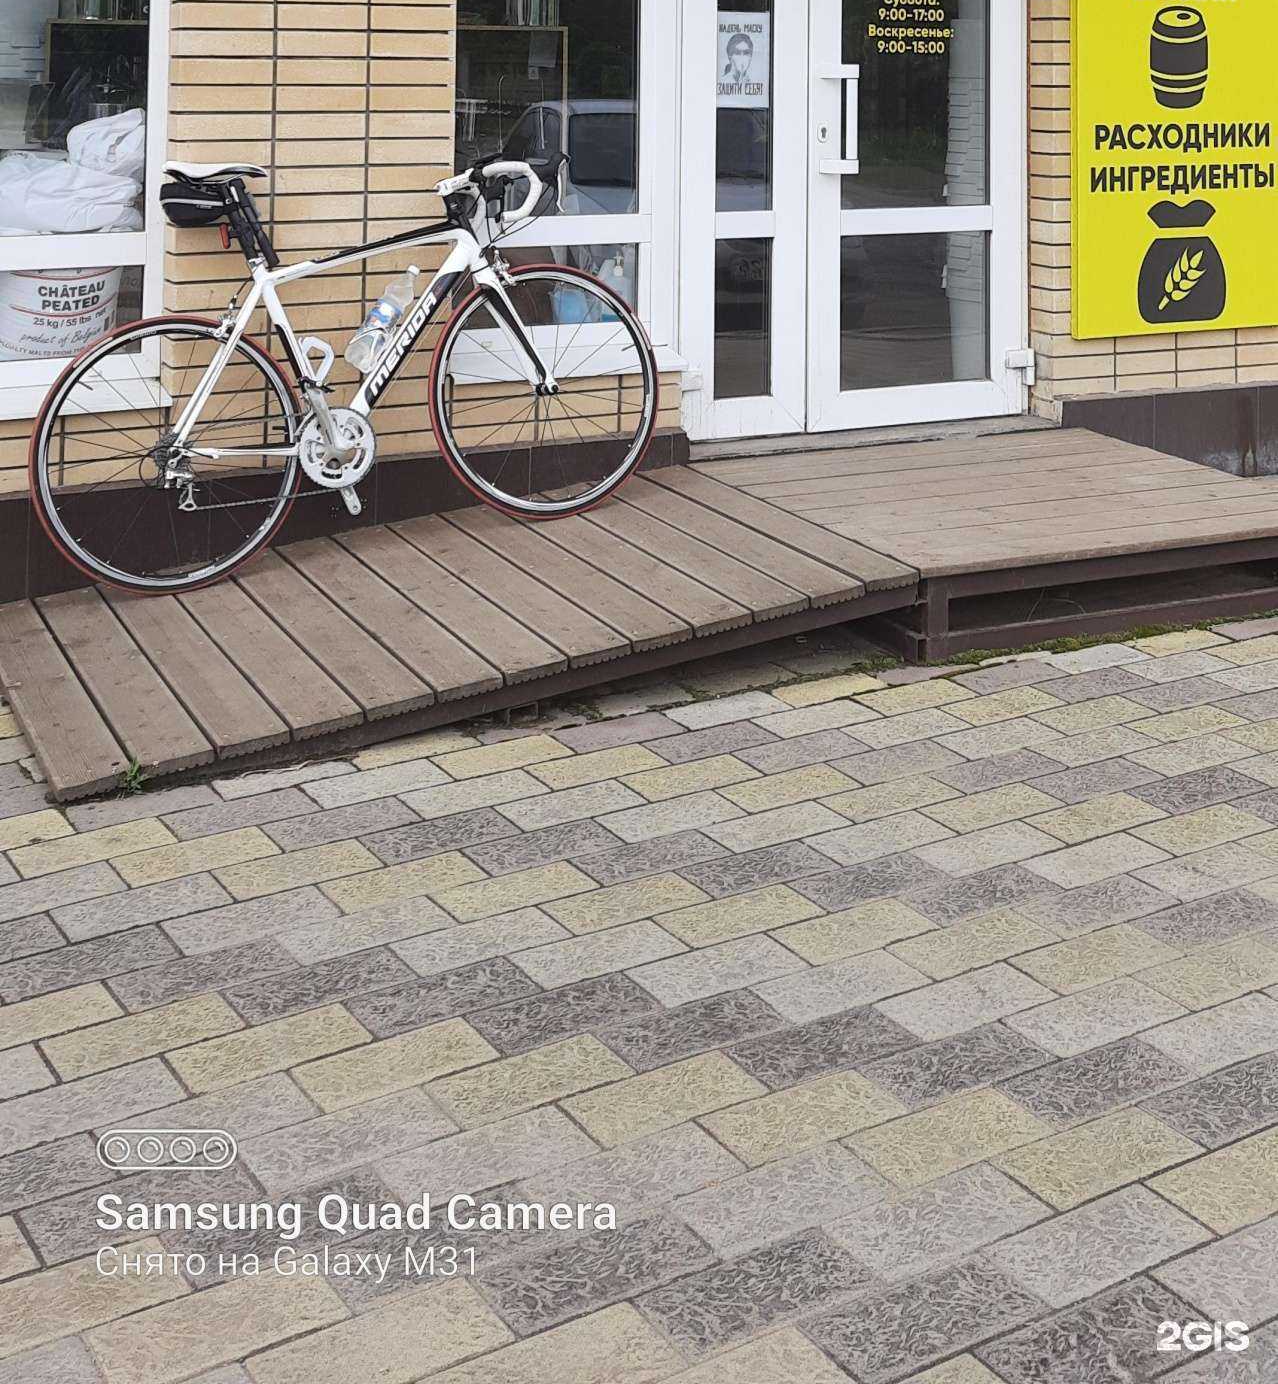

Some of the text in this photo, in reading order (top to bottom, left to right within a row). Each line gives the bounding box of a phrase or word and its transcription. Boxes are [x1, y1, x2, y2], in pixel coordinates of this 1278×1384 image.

[878, 8, 945, 22] 9:00-17:00
[868, 23, 955, 40] Воскресенье:
[877, 40, 945, 54] 9:00-15:00
[1094, 123, 1270, 153] РАСХОДНИКИ
[1090, 163, 1275, 195] ИНГРЕДИЕНТЫ
[38, 280, 105, 298] CHÂTEAU
[41, 295, 100, 311] PEATED
[33, 317, 45, 326] 25
[47, 318, 59, 329] kg
[66, 317, 77, 327] 55
